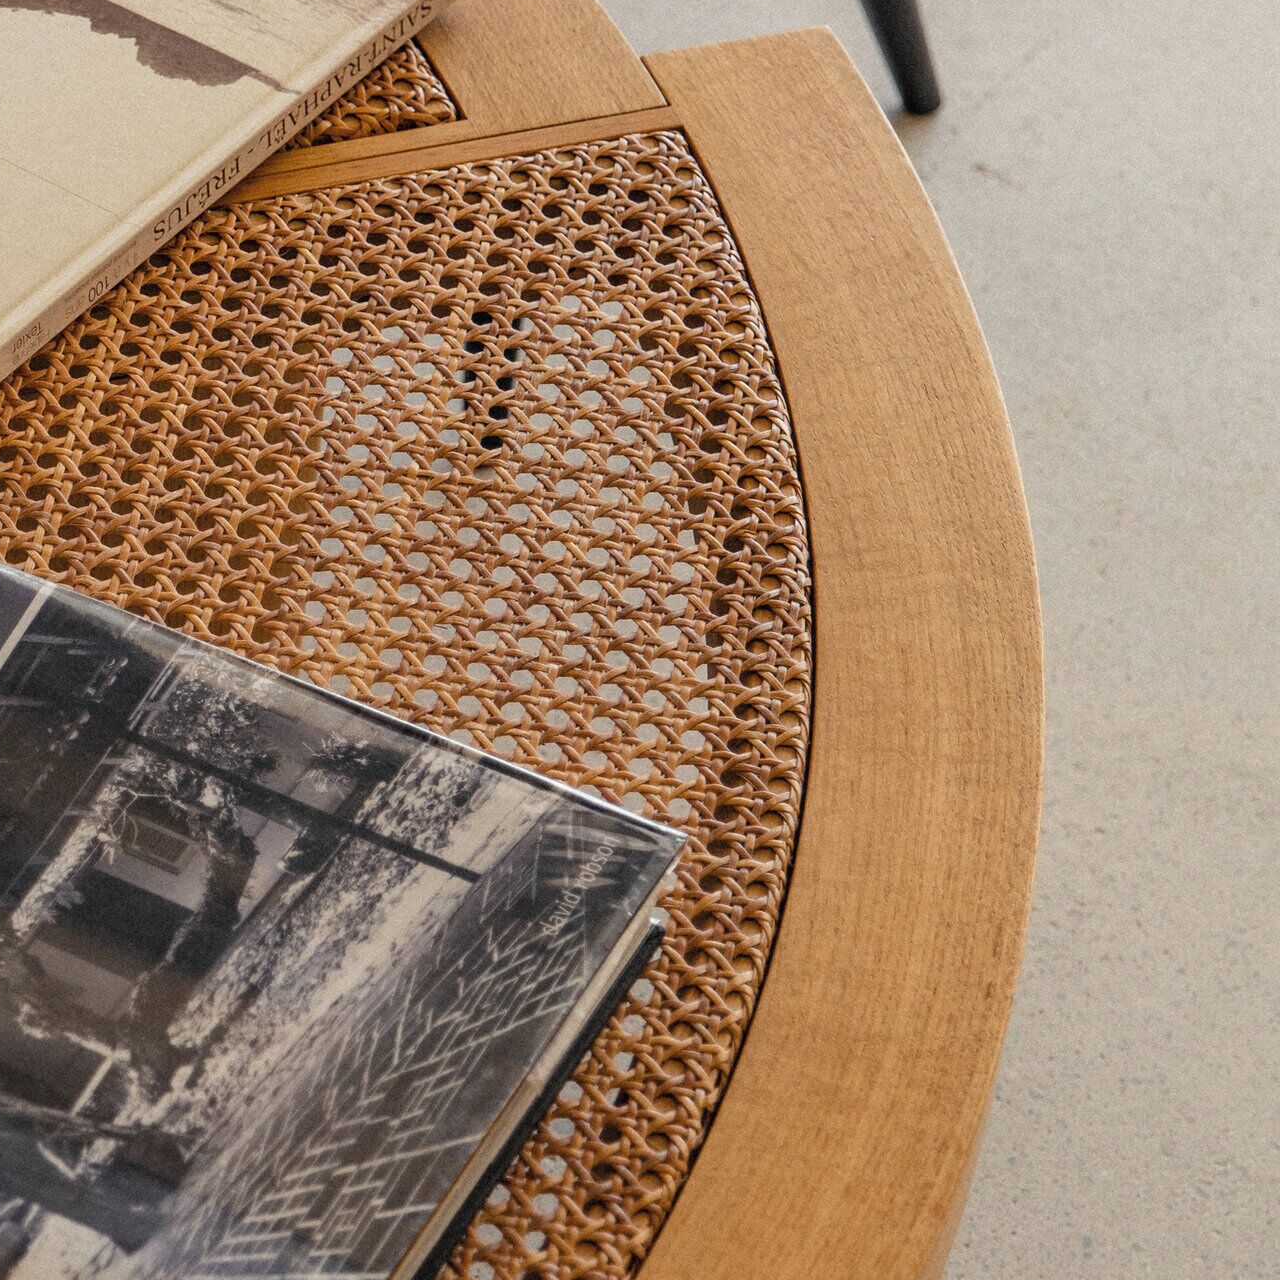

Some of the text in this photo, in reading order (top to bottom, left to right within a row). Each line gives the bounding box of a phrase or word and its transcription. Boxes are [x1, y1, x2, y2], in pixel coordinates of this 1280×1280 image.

[152, 156, 242, 244] FRÉJUS
[87, 276, 110, 303] 100
[11, 321, 45, 353] Texier
